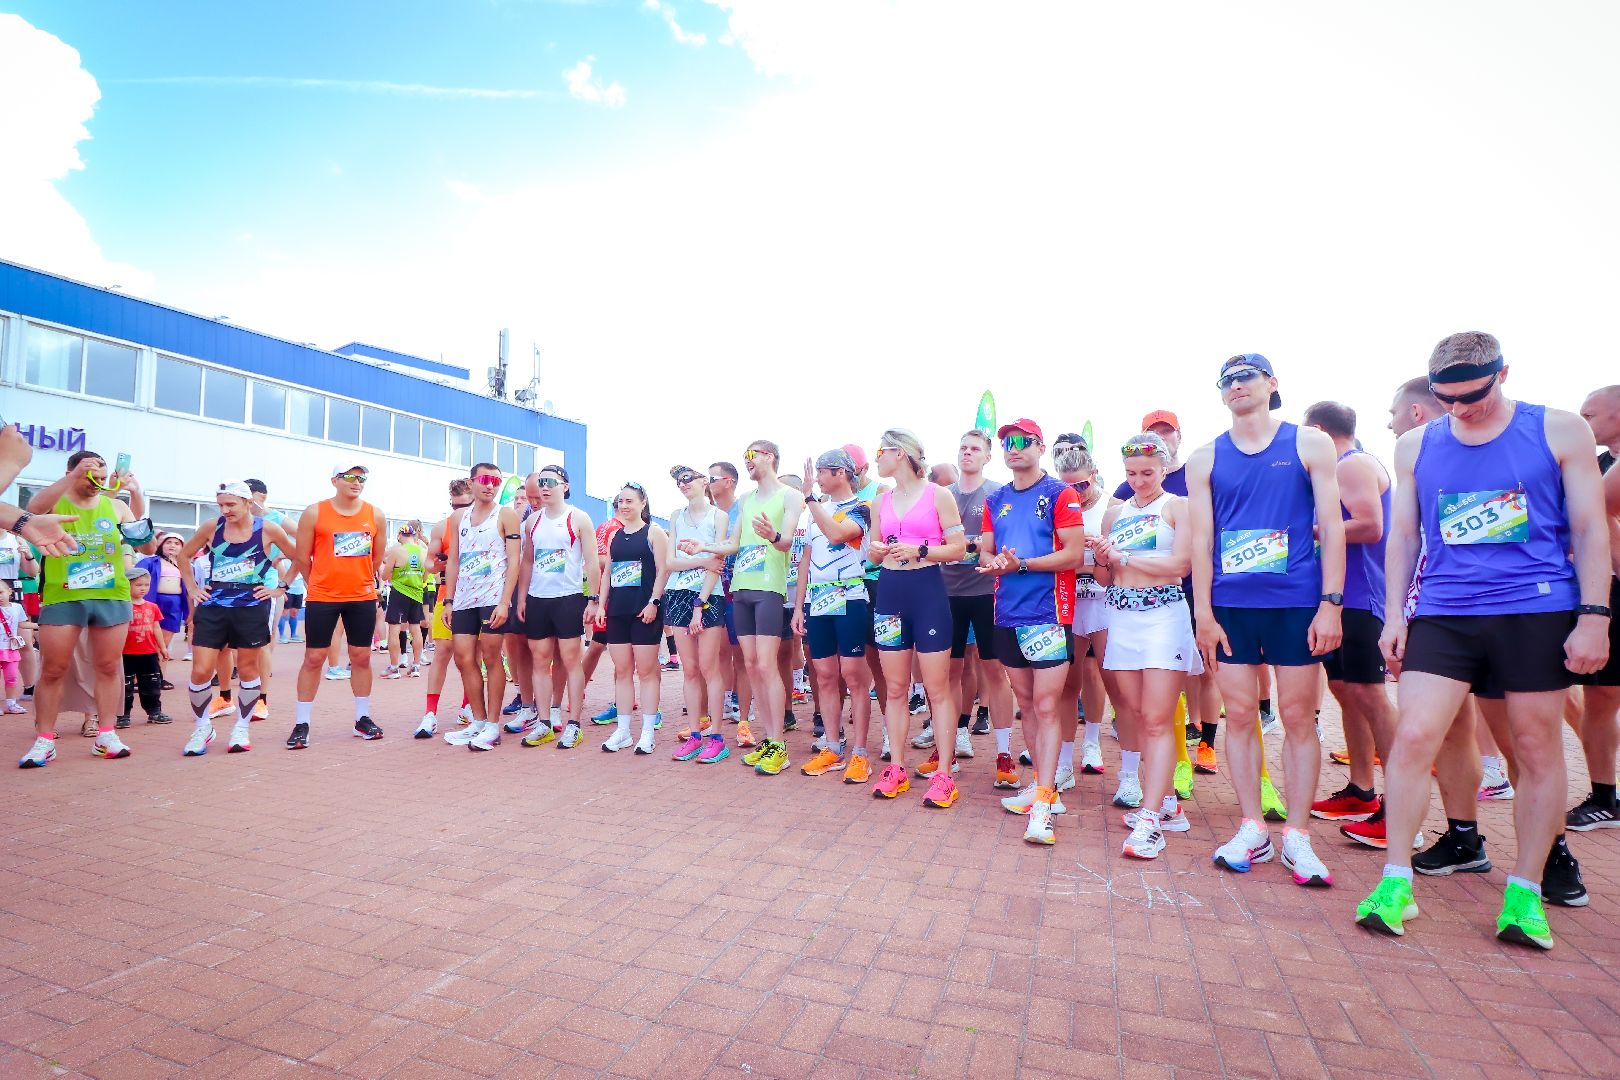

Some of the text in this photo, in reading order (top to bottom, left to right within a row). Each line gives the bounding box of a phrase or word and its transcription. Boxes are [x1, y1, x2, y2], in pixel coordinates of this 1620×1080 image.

[1451, 507, 1499, 538] 303
[1117, 525, 1144, 544] 296
[341, 540, 361, 554] 302
[1231, 542, 1267, 567] 305
[217, 565, 241, 578] 344
[464, 558, 481, 572] 323
[79, 569, 104, 585] 279
[683, 571, 700, 584] 314
[816, 594, 836, 611] 333
[1027, 635, 1053, 656] 308
